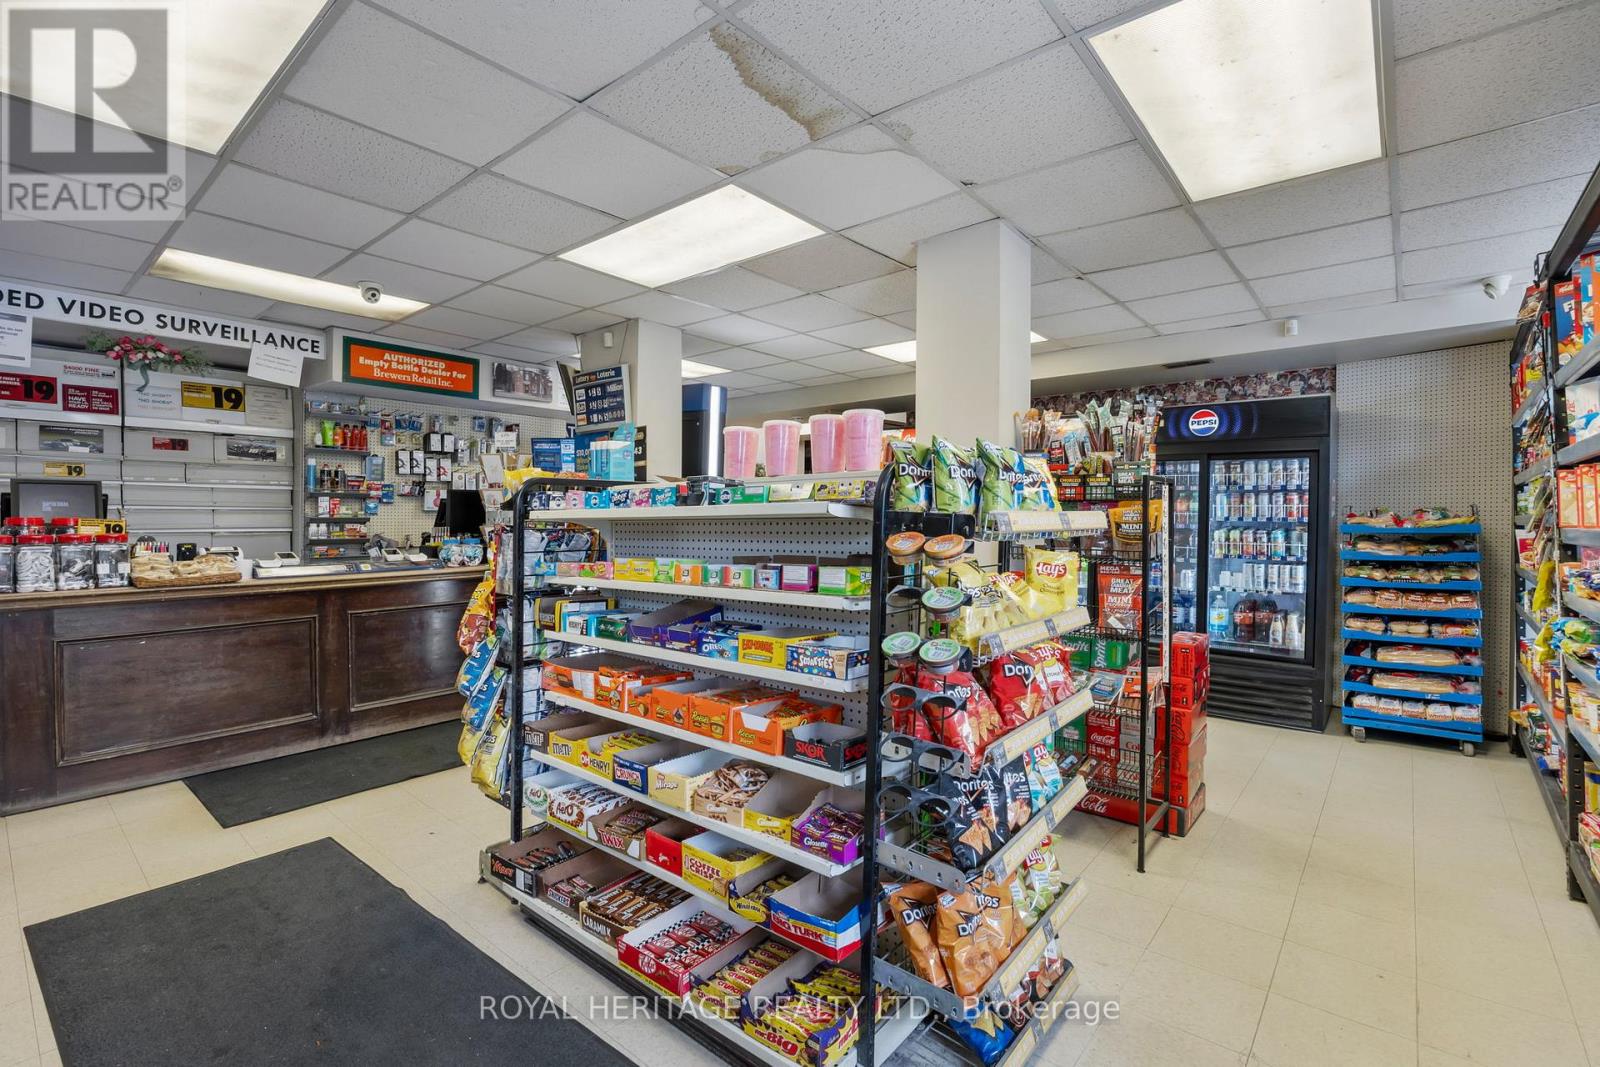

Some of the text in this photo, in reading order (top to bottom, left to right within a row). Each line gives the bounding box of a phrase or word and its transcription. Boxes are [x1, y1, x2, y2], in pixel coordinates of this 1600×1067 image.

[0, 288, 320, 354] ED VIDEO SURVEILLANCE
[358, 356, 467, 380] Empty Bottle Dealer For
[383, 352, 446, 369] AUTHORIZED
[373, 368, 454, 388] Brewers Retail Inc.
[23, 379, 55, 400] 19
[211, 386, 243, 410] 19
[1190, 419, 1217, 427] PEPSI
[171, 438, 187, 450] 19
[66, 465, 83, 477] 19
[795, 741, 826, 761] SKOR
[589, 756, 610, 775] HENRY!
[689, 857, 721, 877] COFFEE
[689, 865, 715, 881] CRISP
[771, 914, 825, 943] BIG TURK
[728, 971, 754, 985] crunch
[739, 964, 764, 978] crunch
[717, 980, 744, 996] crunch
[767, 1031, 799, 1056] Big
